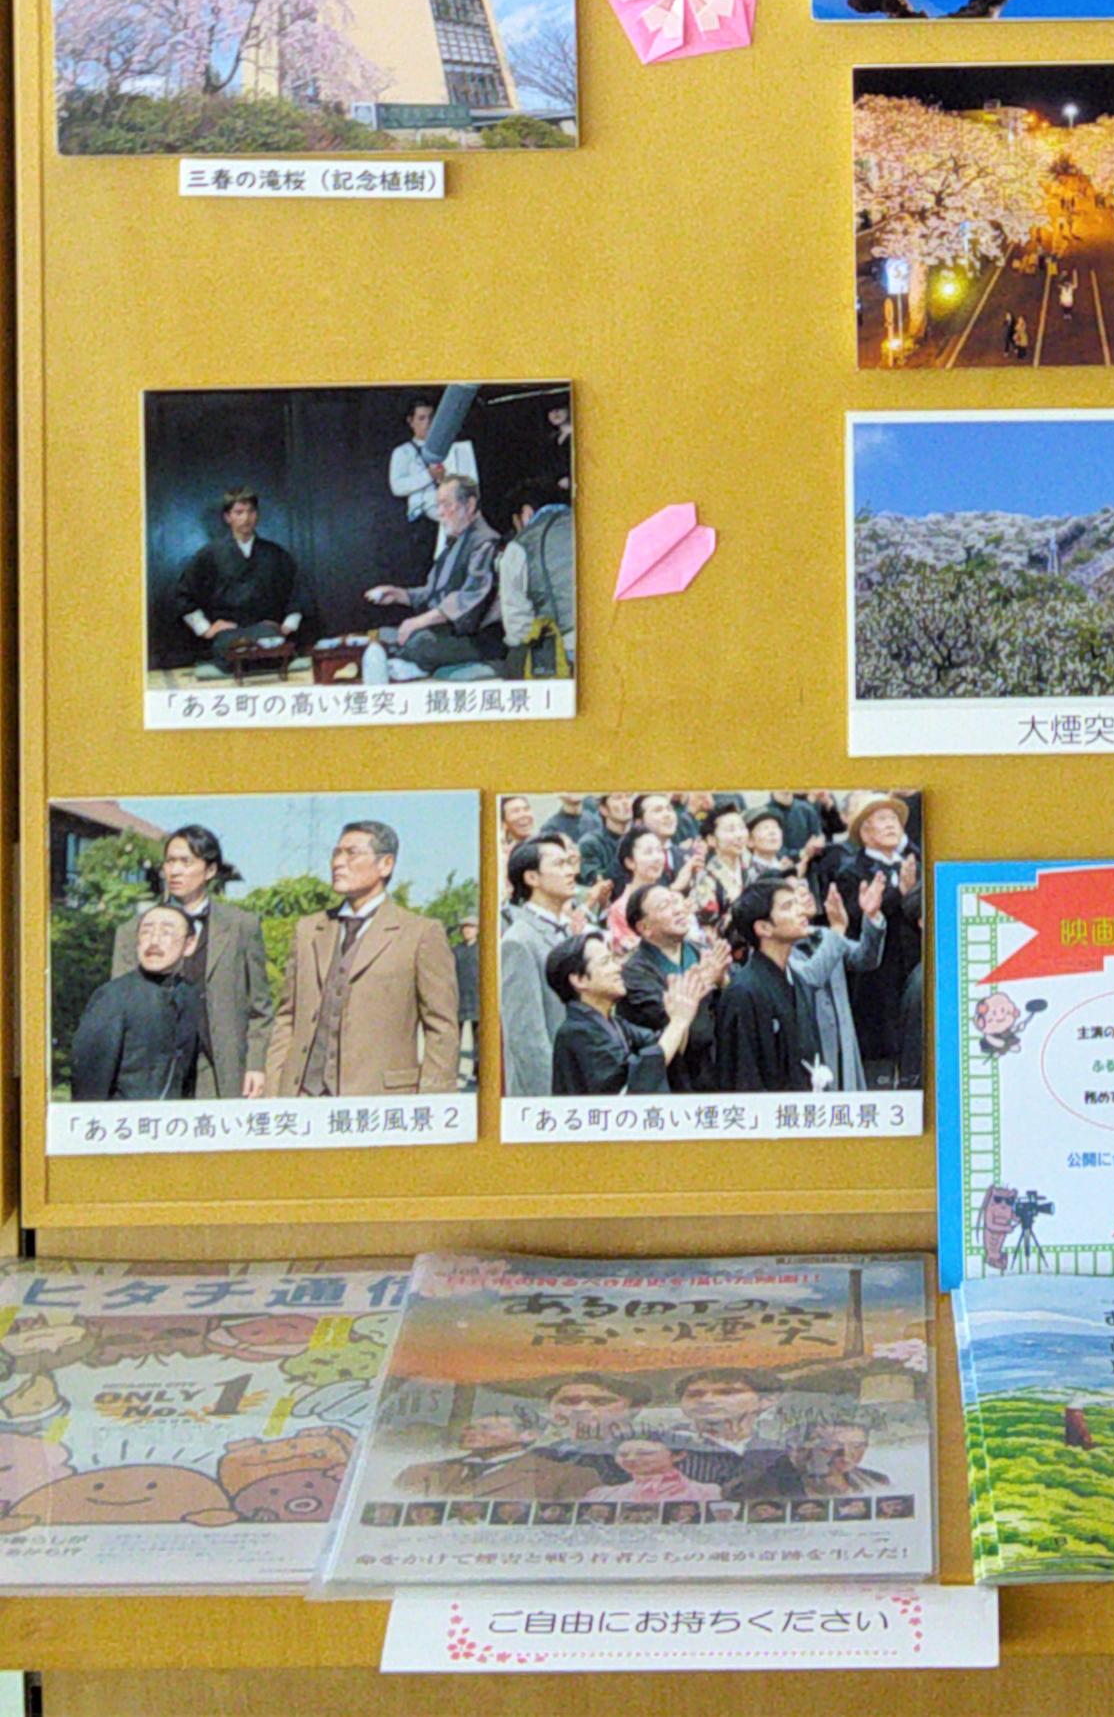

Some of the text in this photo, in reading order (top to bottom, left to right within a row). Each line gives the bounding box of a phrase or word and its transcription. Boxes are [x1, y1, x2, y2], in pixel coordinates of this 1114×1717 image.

[94, 1388, 206, 1404] ONLY
[487, 1607, 891, 1635] ご自由にお持ちください
